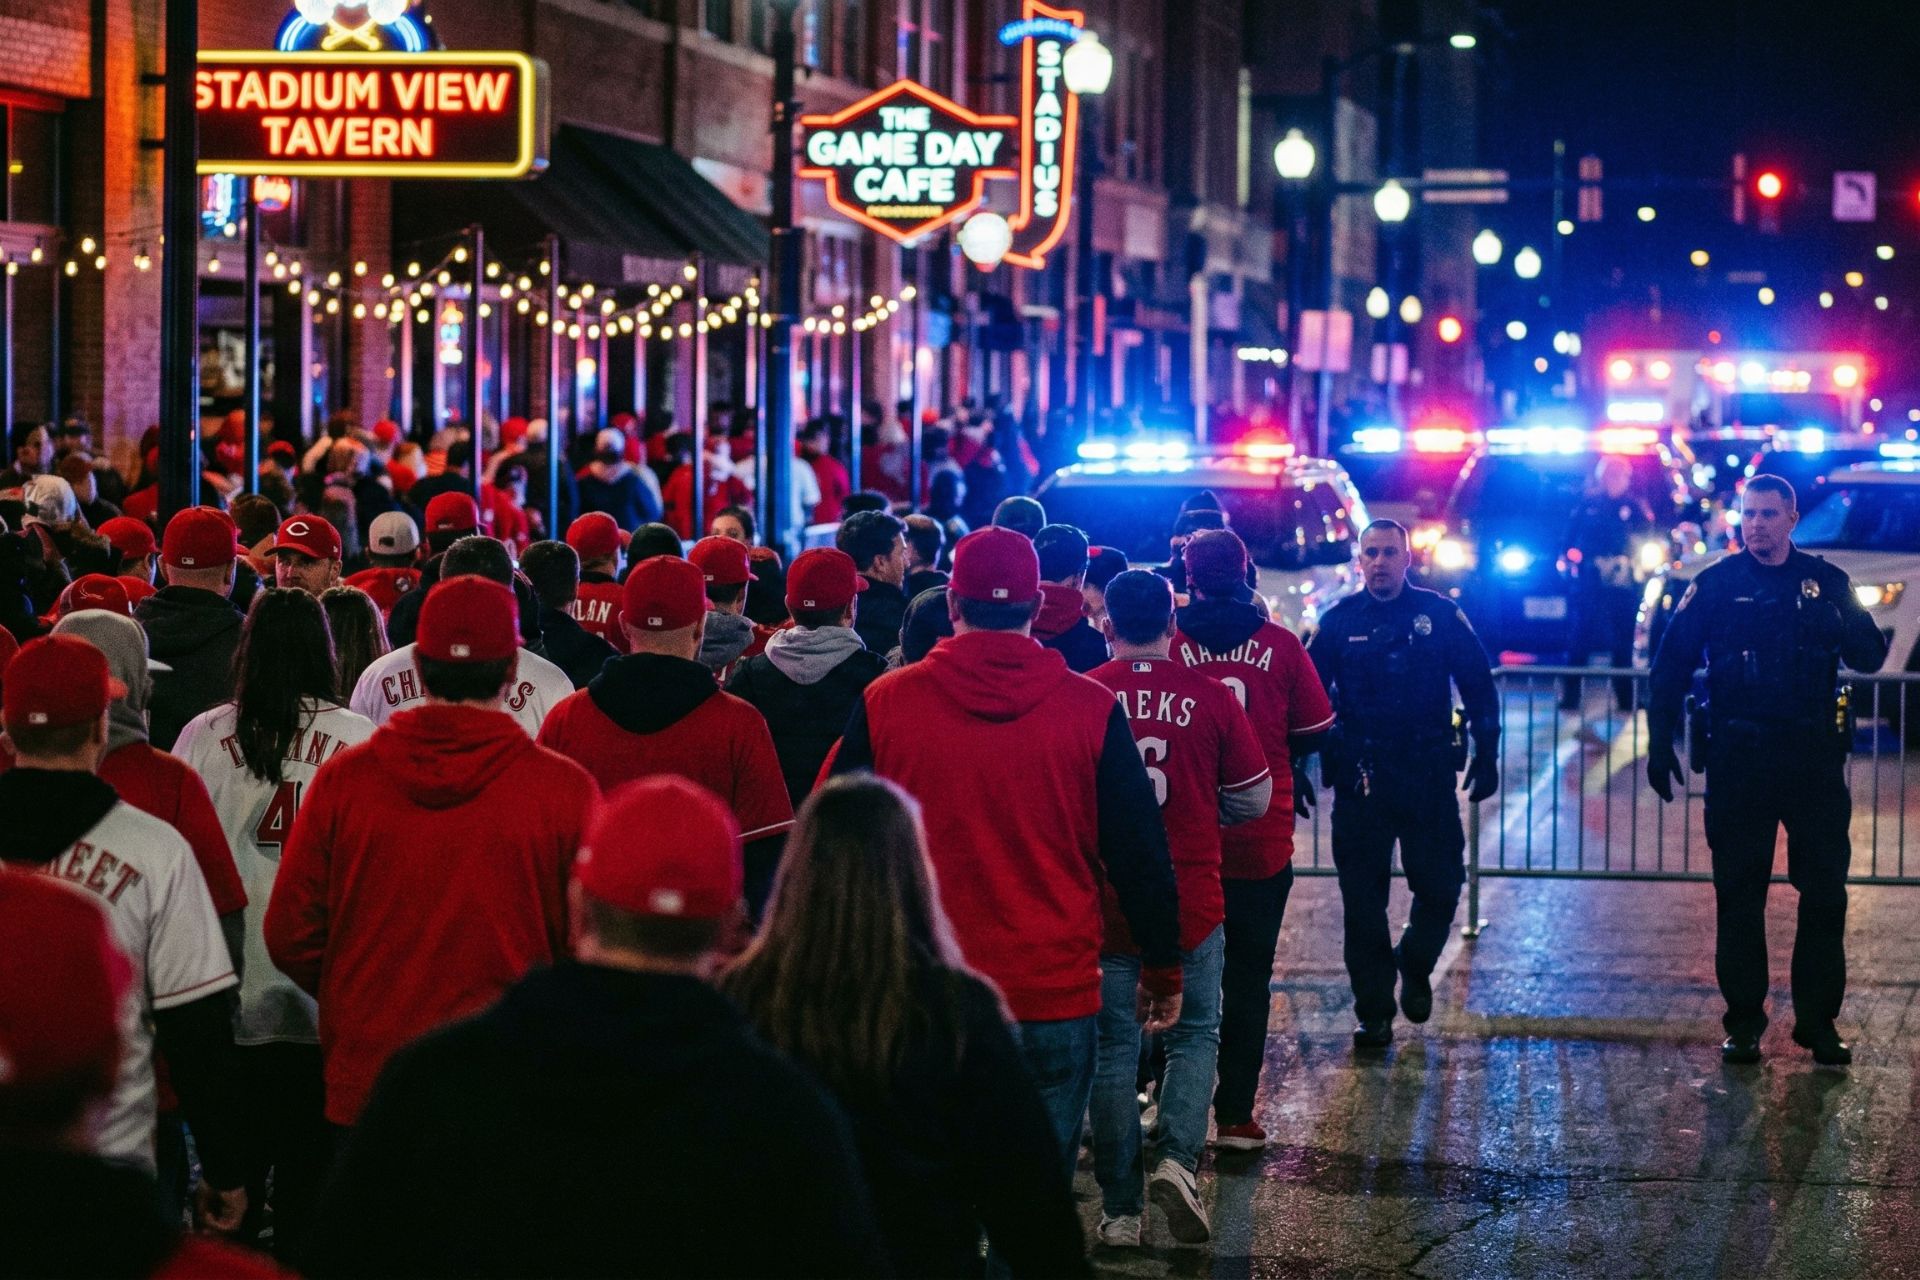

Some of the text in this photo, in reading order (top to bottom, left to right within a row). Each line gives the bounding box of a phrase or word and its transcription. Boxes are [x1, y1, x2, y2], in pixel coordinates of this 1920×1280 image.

[196, 70, 511, 111] STADIUM VIEW
[261, 116, 434, 157] TAVERN
[878, 106, 932, 132] THE
[1033, 40, 1062, 218] STADIUS
[807, 130, 1004, 167] GAME DAY
[853, 166, 956, 203] CAFE
